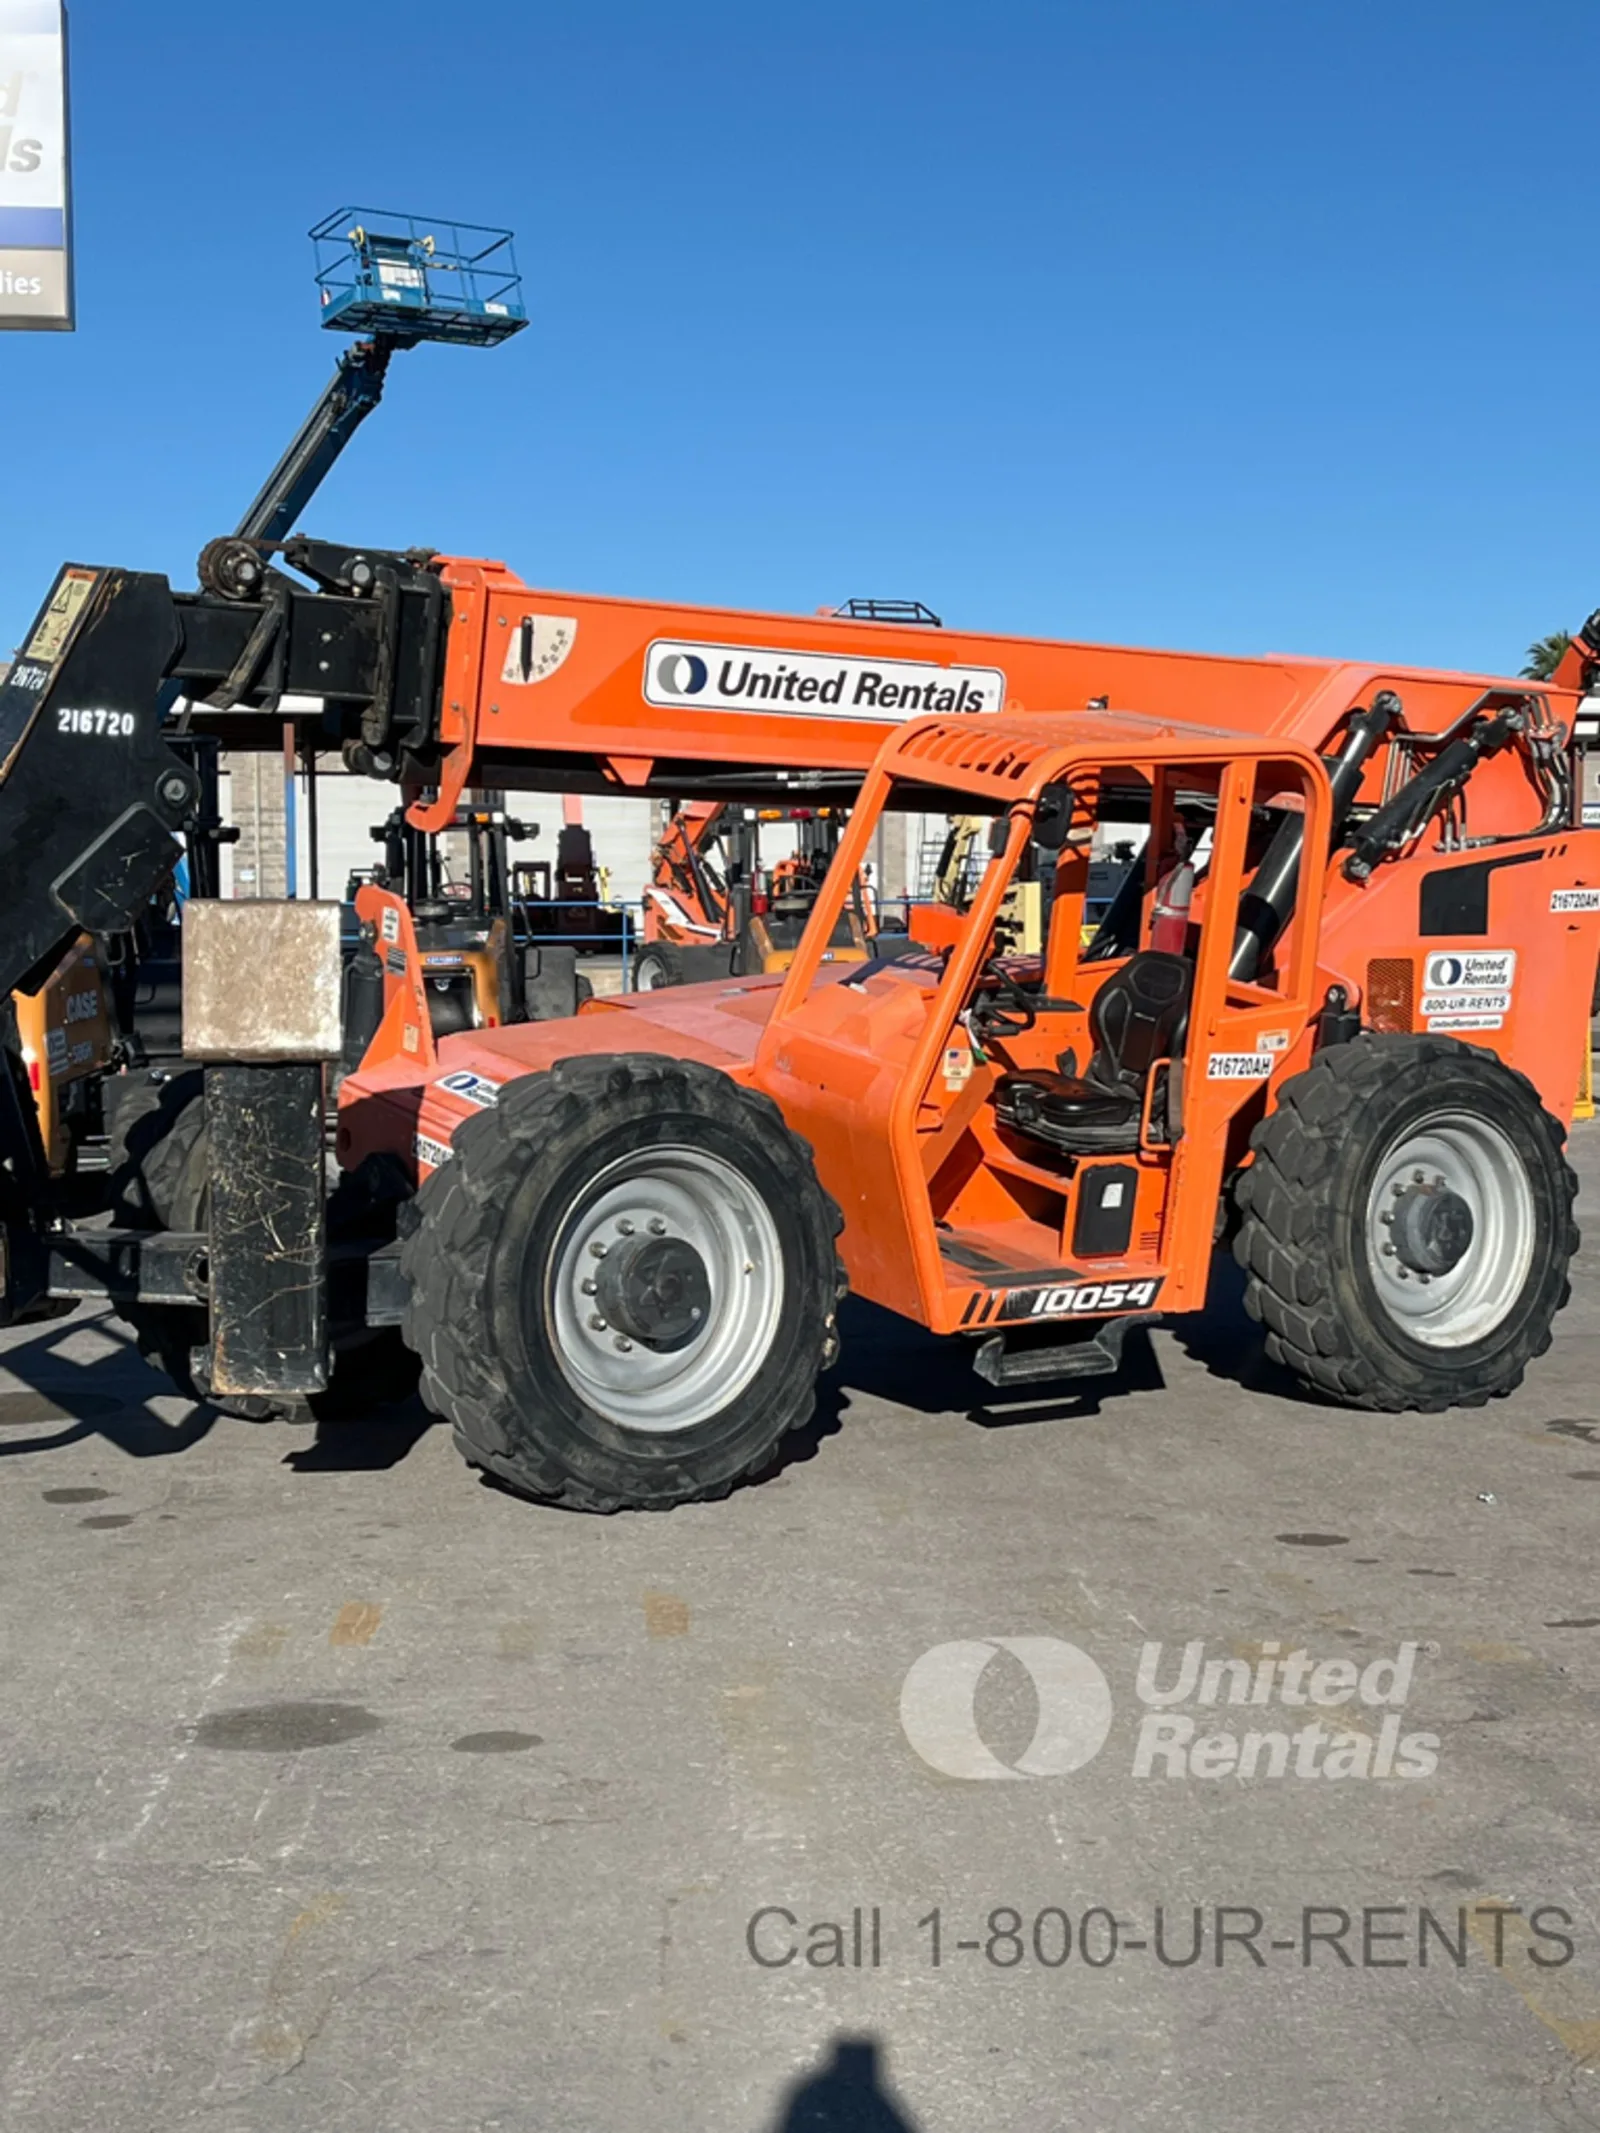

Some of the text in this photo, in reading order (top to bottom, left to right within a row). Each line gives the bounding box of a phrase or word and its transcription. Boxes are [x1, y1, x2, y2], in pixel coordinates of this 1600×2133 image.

[718, 660, 985, 713] United Rentals
[57, 708, 135, 736] 216720
[1465, 957, 1508, 972] United
[1462, 972, 1507, 986] Rentals
[66, 989, 98, 1023] CASE
[1425, 996, 1506, 1011] 800-UR-RENTS
[1208, 1057, 1271, 1076] 216720AH
[1031, 1282, 1155, 1314] 10054
